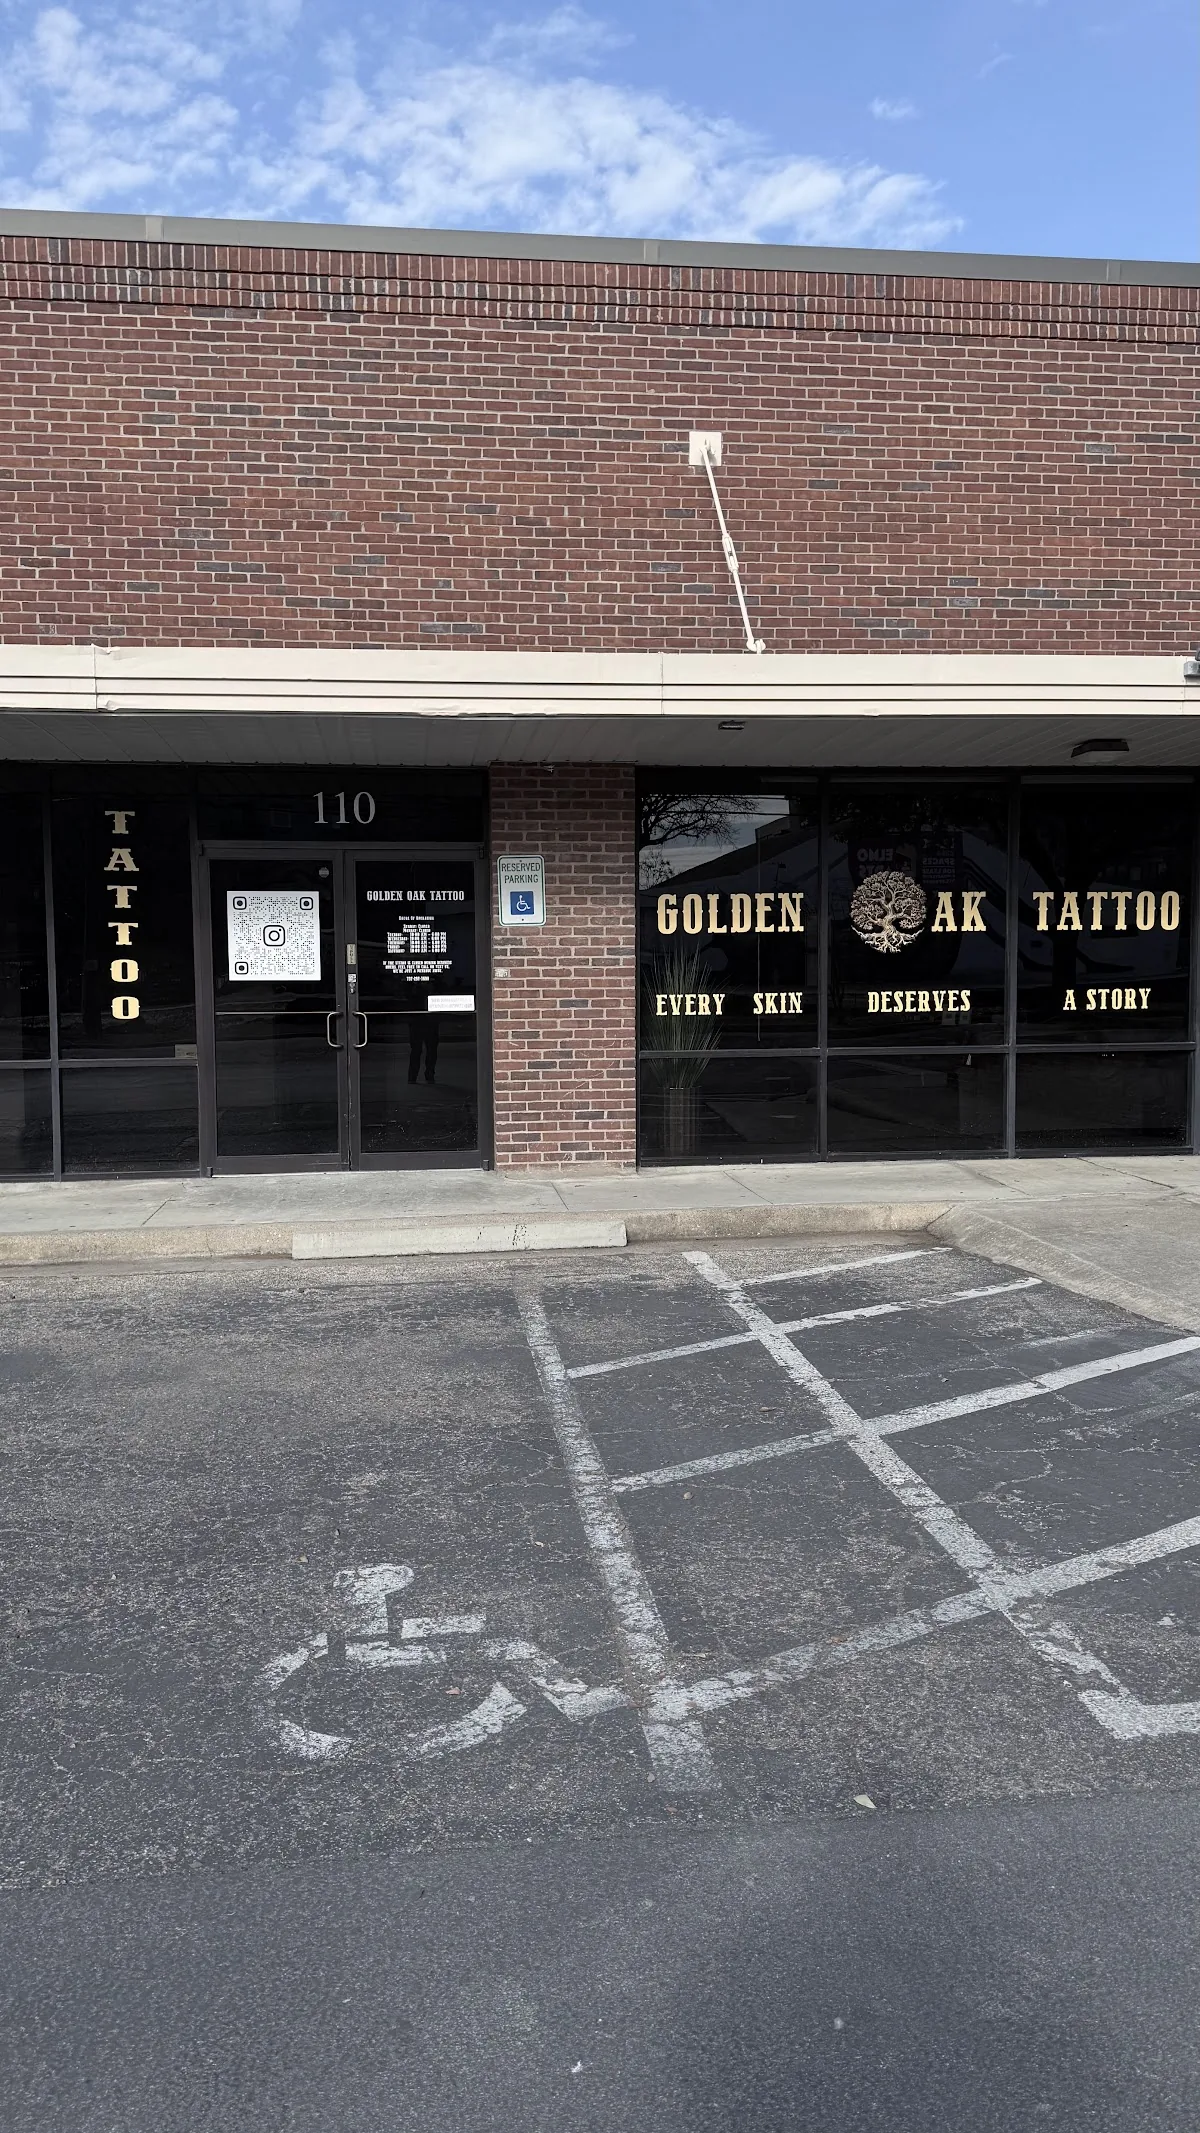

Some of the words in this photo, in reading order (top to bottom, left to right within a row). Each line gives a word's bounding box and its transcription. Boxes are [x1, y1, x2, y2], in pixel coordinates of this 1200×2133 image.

[314, 791, 376, 824] 110
[501, 862, 541, 872] RESERVED
[504, 874, 539, 884] PARKING
[366, 890, 403, 902] GOLDEN
[406, 890, 427, 902] OAK
[429, 890, 465, 902] TATTOO
[103, 810, 141, 1020] TATTOO
[656, 892, 805, 935] GOLDEN
[1032, 890, 1181, 931] TATTOO
[655, 993, 726, 1016] EVERY
[753, 991, 803, 1015] SKIN
[867, 989, 971, 1013] DESERVES
[1062, 989, 1077, 1011] A
[1086, 987, 1152, 1011] STORY
